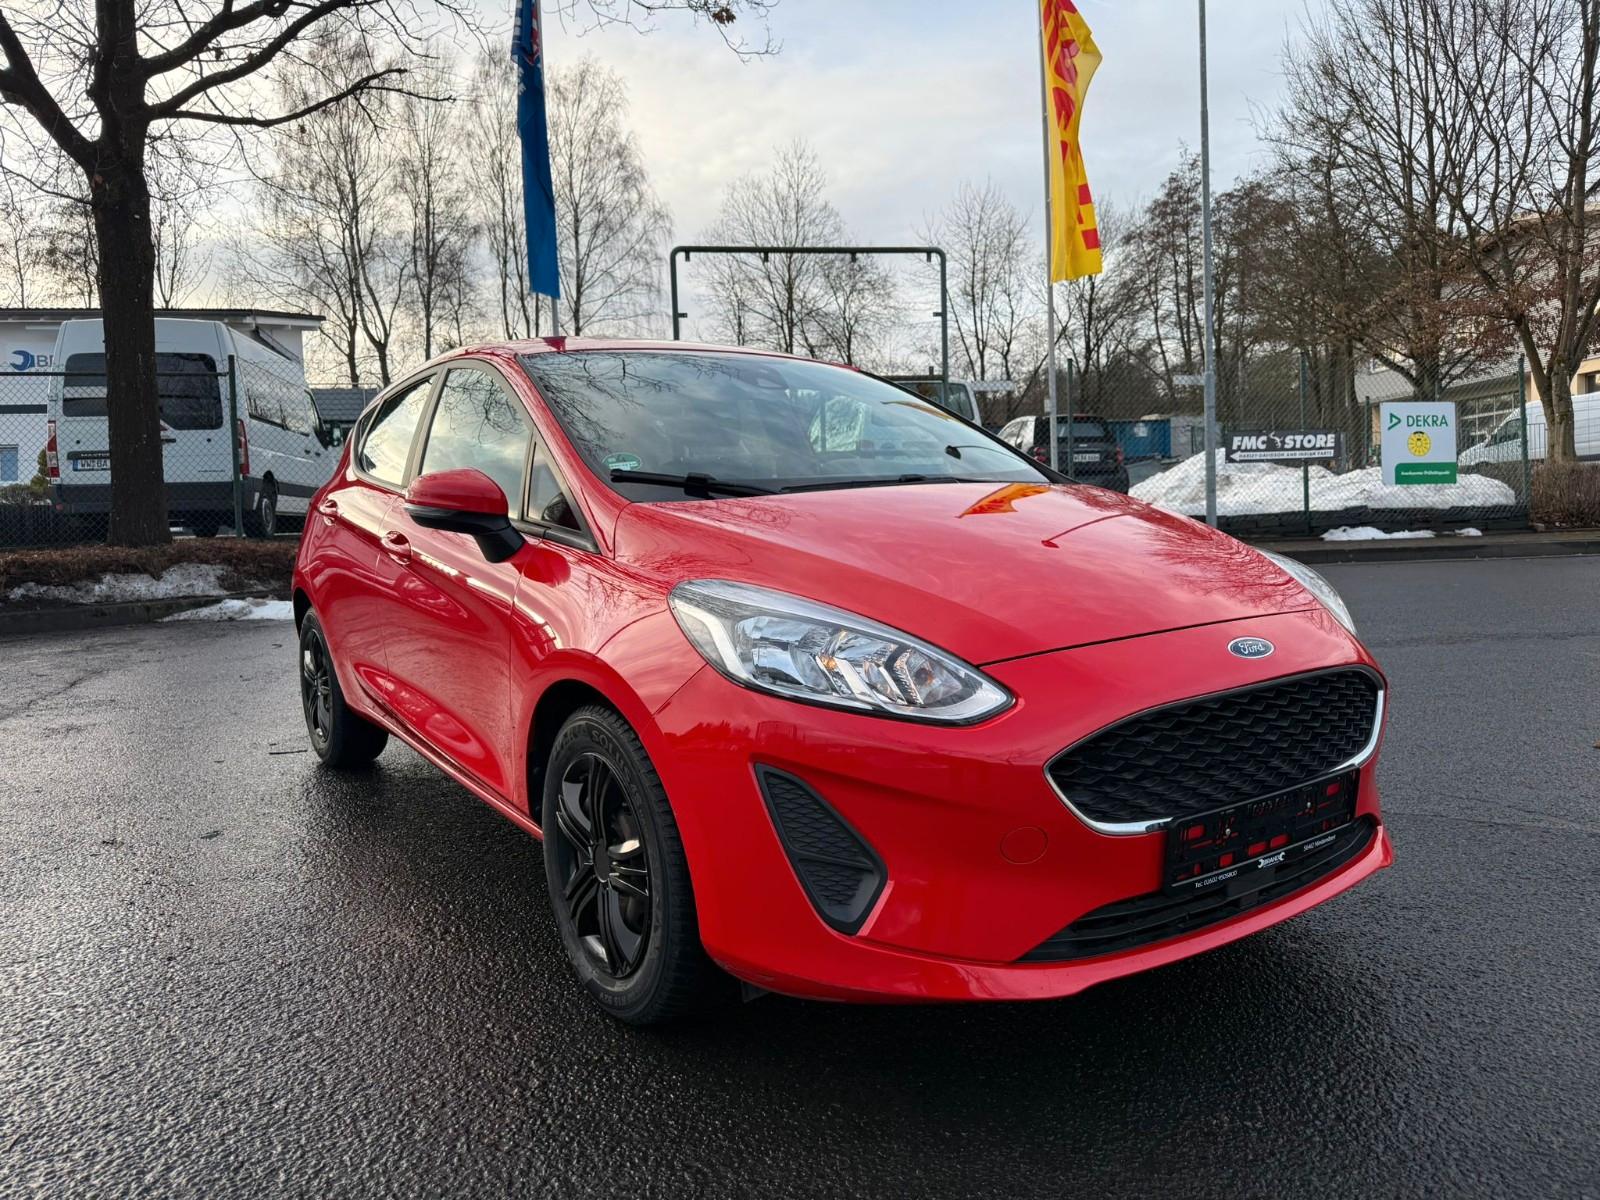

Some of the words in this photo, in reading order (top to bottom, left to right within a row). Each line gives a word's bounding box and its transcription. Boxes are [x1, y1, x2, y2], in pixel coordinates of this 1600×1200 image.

[1406, 414, 1448, 428] DEKRA
[1231, 435, 1268, 450] FMC
[1283, 433, 1336, 449] STORE
[1238, 641, 1266, 655] Ford
